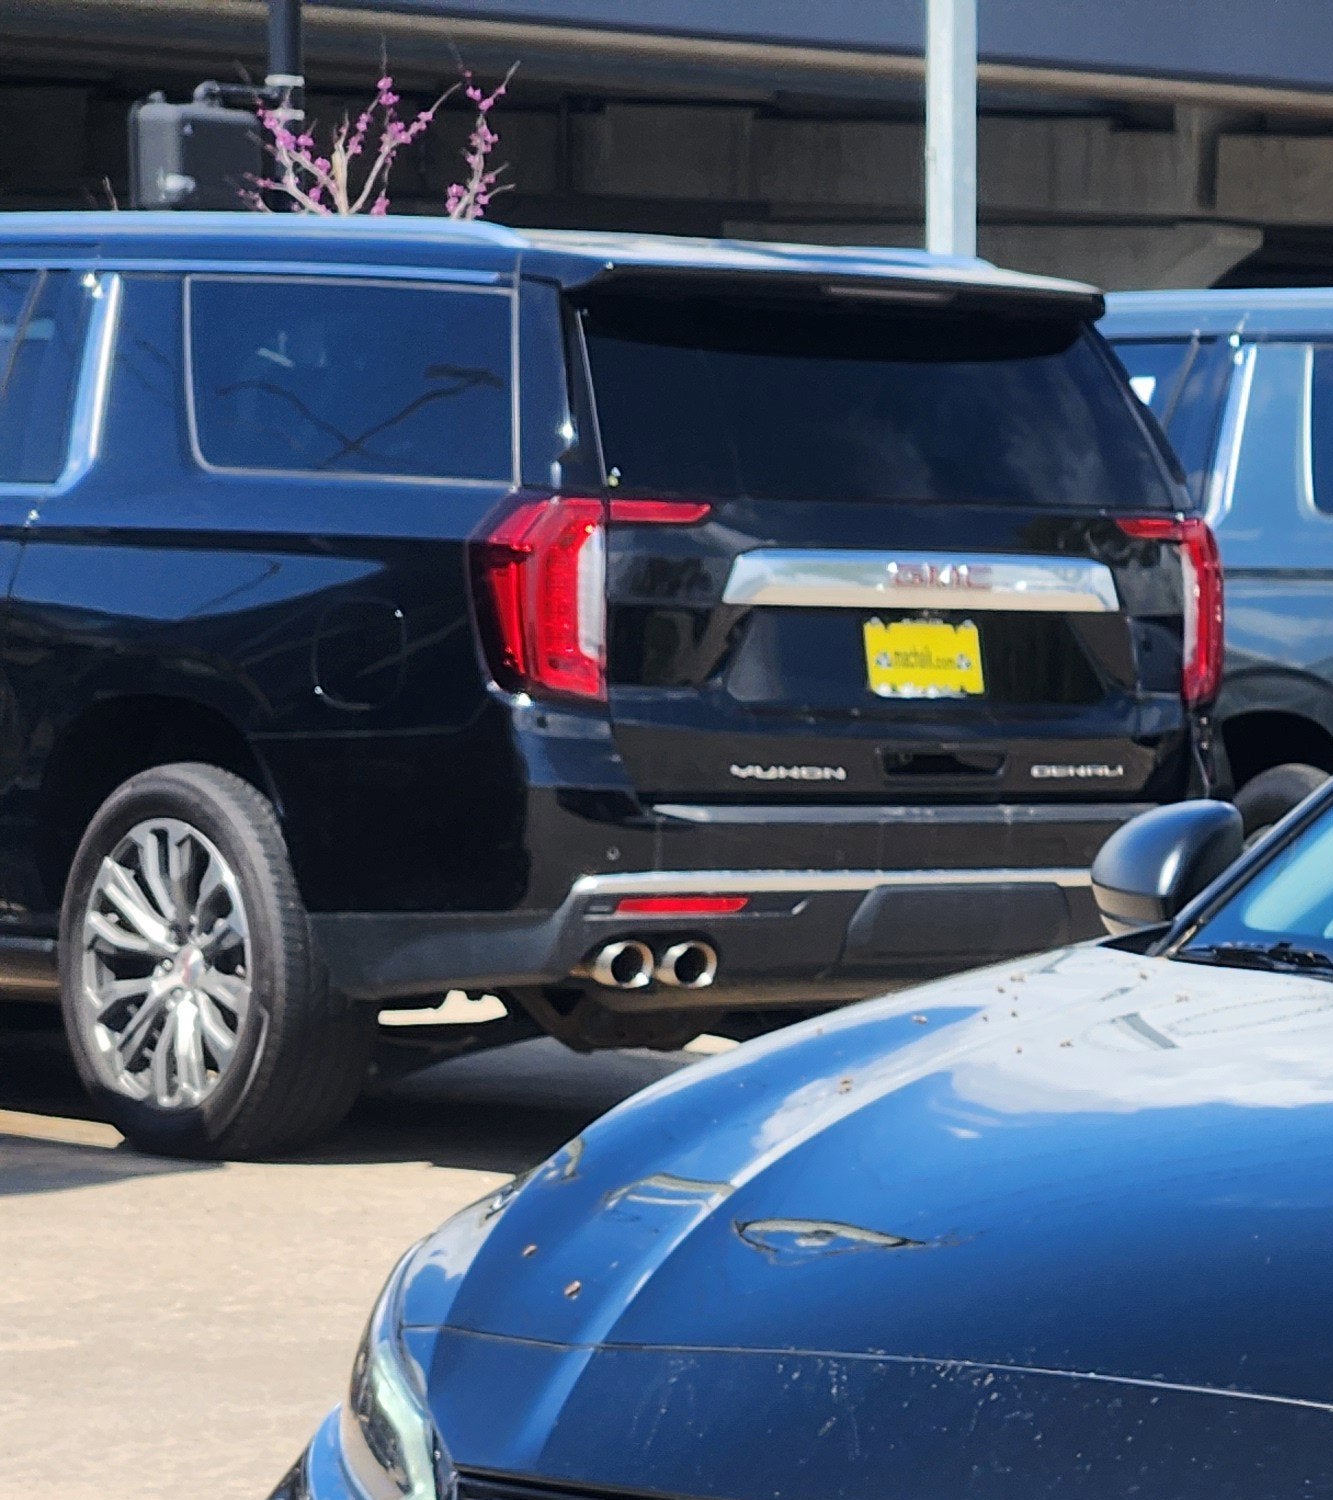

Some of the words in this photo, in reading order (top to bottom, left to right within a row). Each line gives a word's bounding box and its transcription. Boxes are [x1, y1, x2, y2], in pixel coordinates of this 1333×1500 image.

[889, 563, 993, 589] GMC
[730, 763, 847, 781] YUKON
[1029, 764, 1124, 778] DENALI
